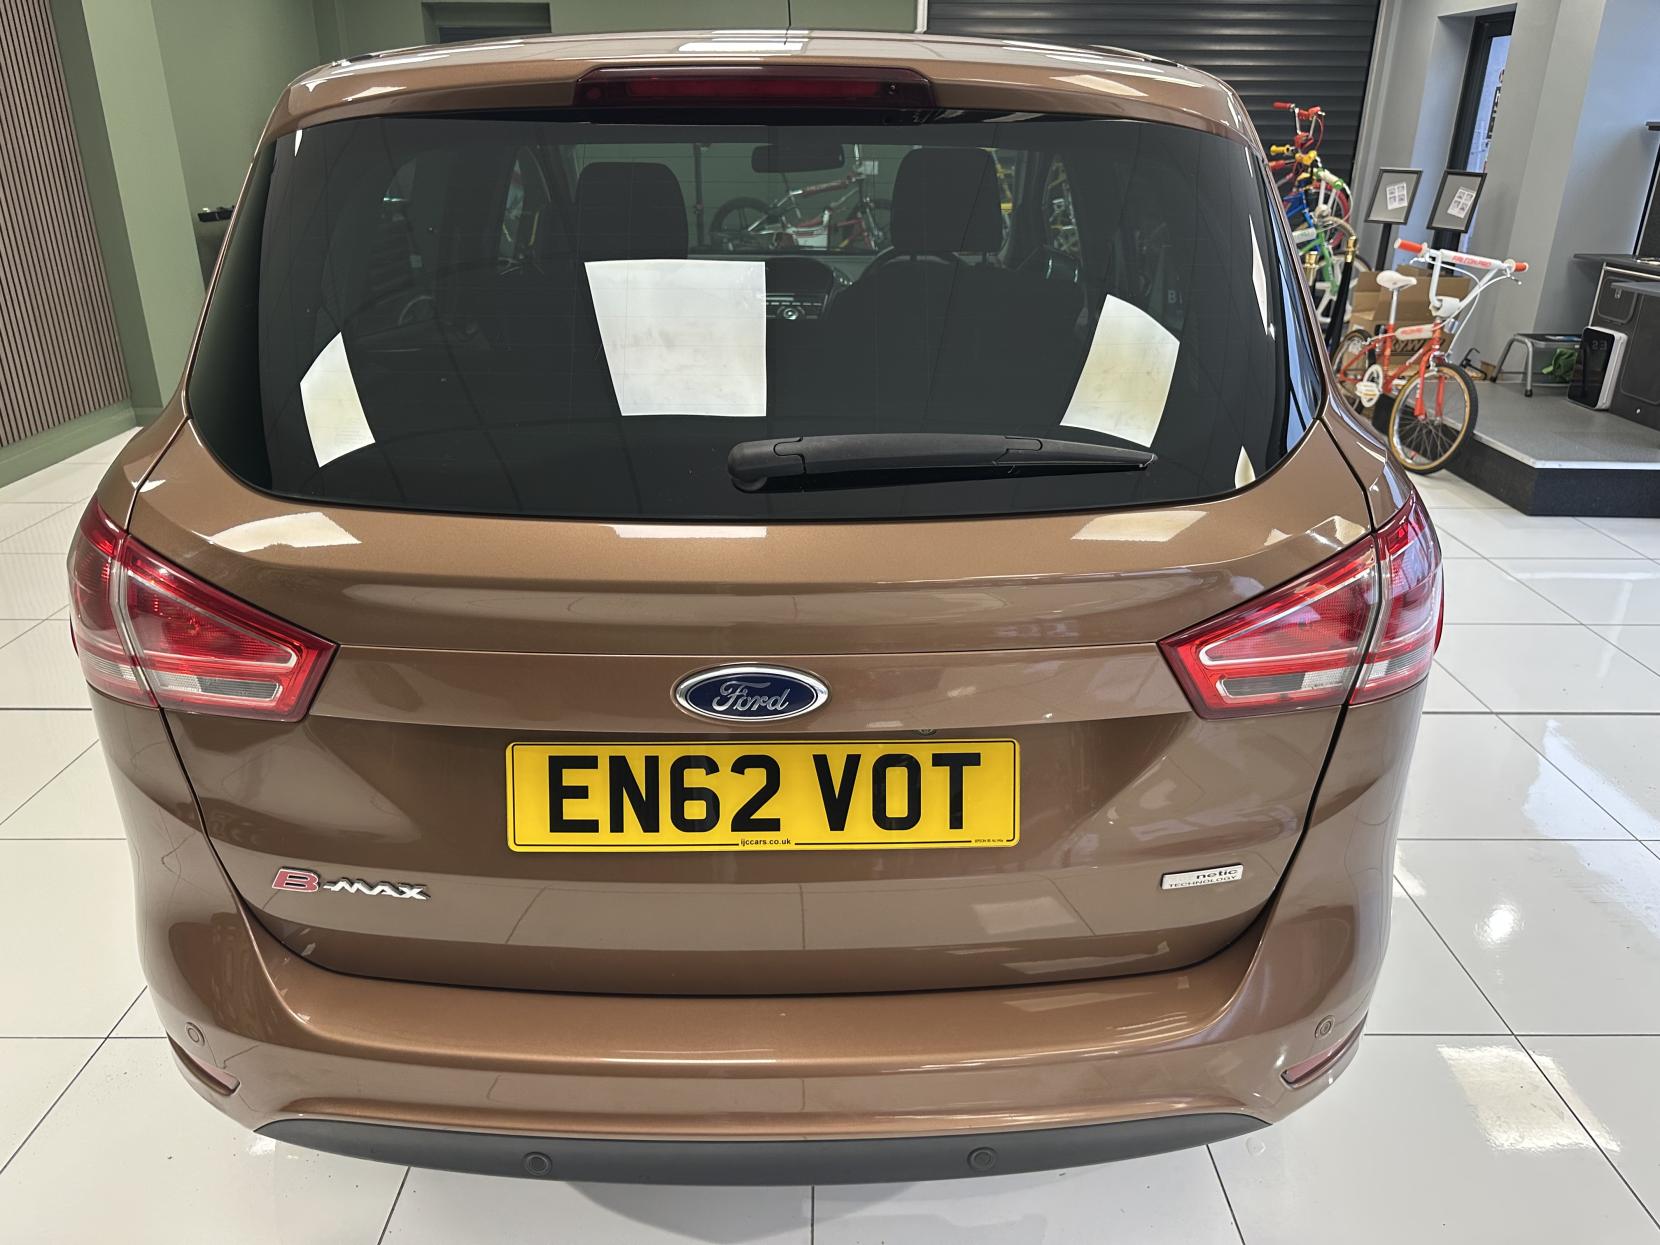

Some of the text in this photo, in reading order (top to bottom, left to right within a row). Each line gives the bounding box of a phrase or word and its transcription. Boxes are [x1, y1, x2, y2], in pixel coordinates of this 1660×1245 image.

[711, 680, 791, 711] Ford
[548, 753, 981, 833] EN62 VOT
[740, 838, 791, 847] ijccars.co.uk
[271, 866, 431, 900] B-MAX
[1168, 875, 1238, 888] TECHNOLOGY
